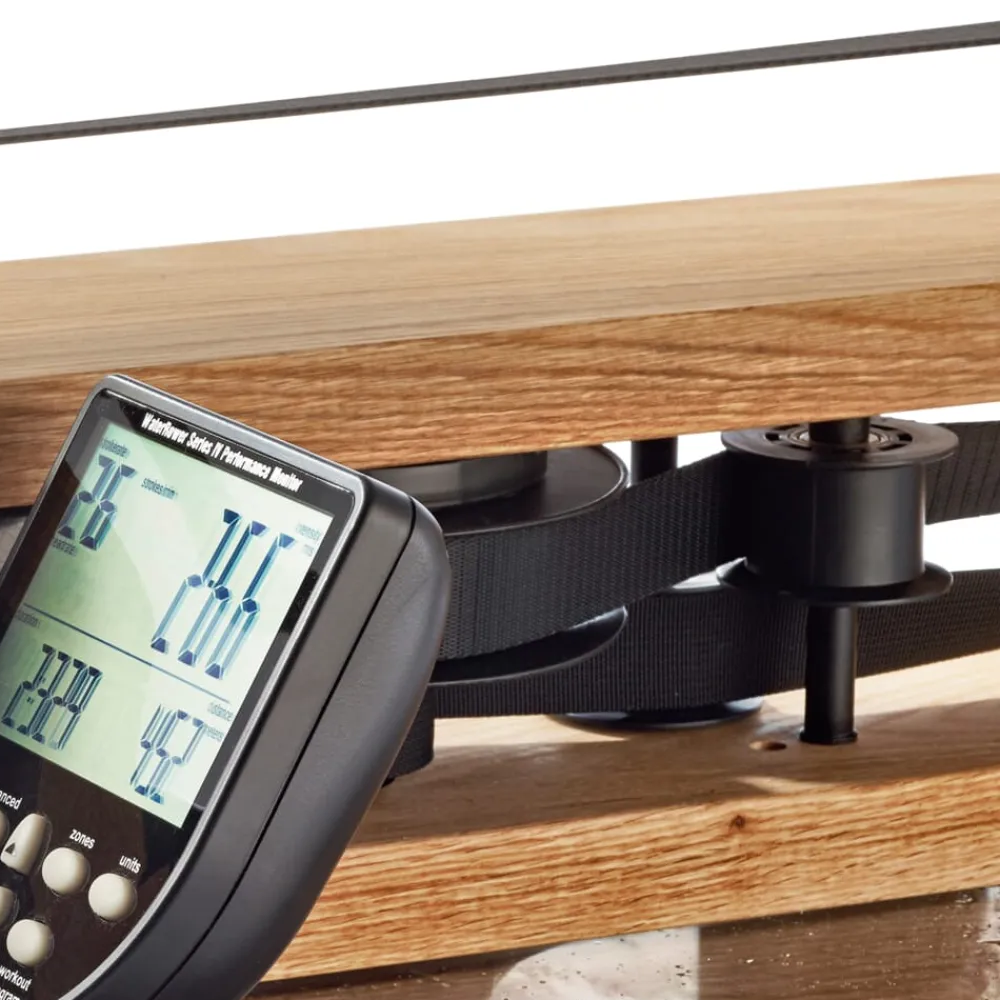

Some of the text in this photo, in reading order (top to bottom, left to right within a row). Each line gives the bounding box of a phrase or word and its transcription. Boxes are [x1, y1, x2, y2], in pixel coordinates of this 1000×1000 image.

[140, 412, 189, 445] WaterRower
[186, 431, 212, 455] Series
[220, 444, 271, 480] Performance
[268, 465, 304, 493] Monitor
[58, 453, 138, 552] 26
[69, 828, 96, 849] zones
[119, 854, 142, 875] units
